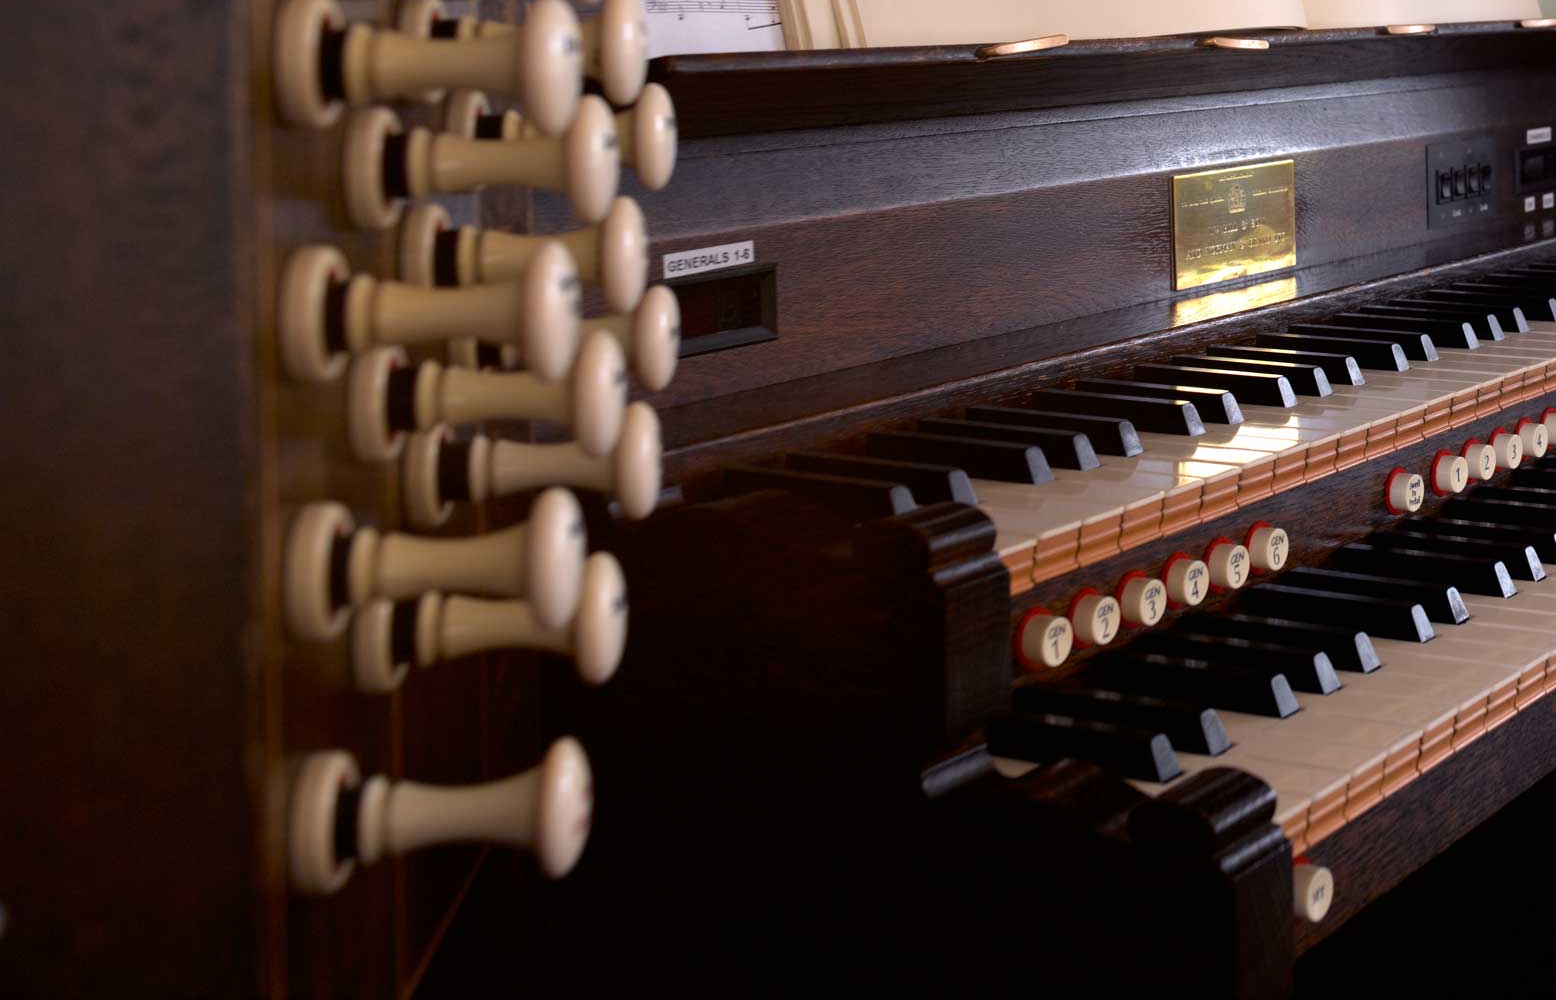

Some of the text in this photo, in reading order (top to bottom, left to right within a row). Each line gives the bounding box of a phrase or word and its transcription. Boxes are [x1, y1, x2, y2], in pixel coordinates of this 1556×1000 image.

[667, 248, 750, 273] GENERALS 1-6
[1536, 434, 1542, 448] 4
[1511, 444, 1517, 459] 3
[1483, 455, 1490, 471] 2
[1455, 467, 1461, 483] 1
[1271, 535, 1284, 547] GEN
[1231, 551, 1245, 564] GEN
[1273, 548, 1281, 564] 6
[1189, 568, 1203, 580] GEN
[1233, 565, 1241, 583] 5
[1146, 586, 1161, 600] GEN
[1191, 581, 1199, 598] 4
[1096, 604, 1114, 618] GEN
[1148, 601, 1157, 620] 3
[1101, 619, 1111, 638] 2
[1051, 640, 1060, 659] 1
